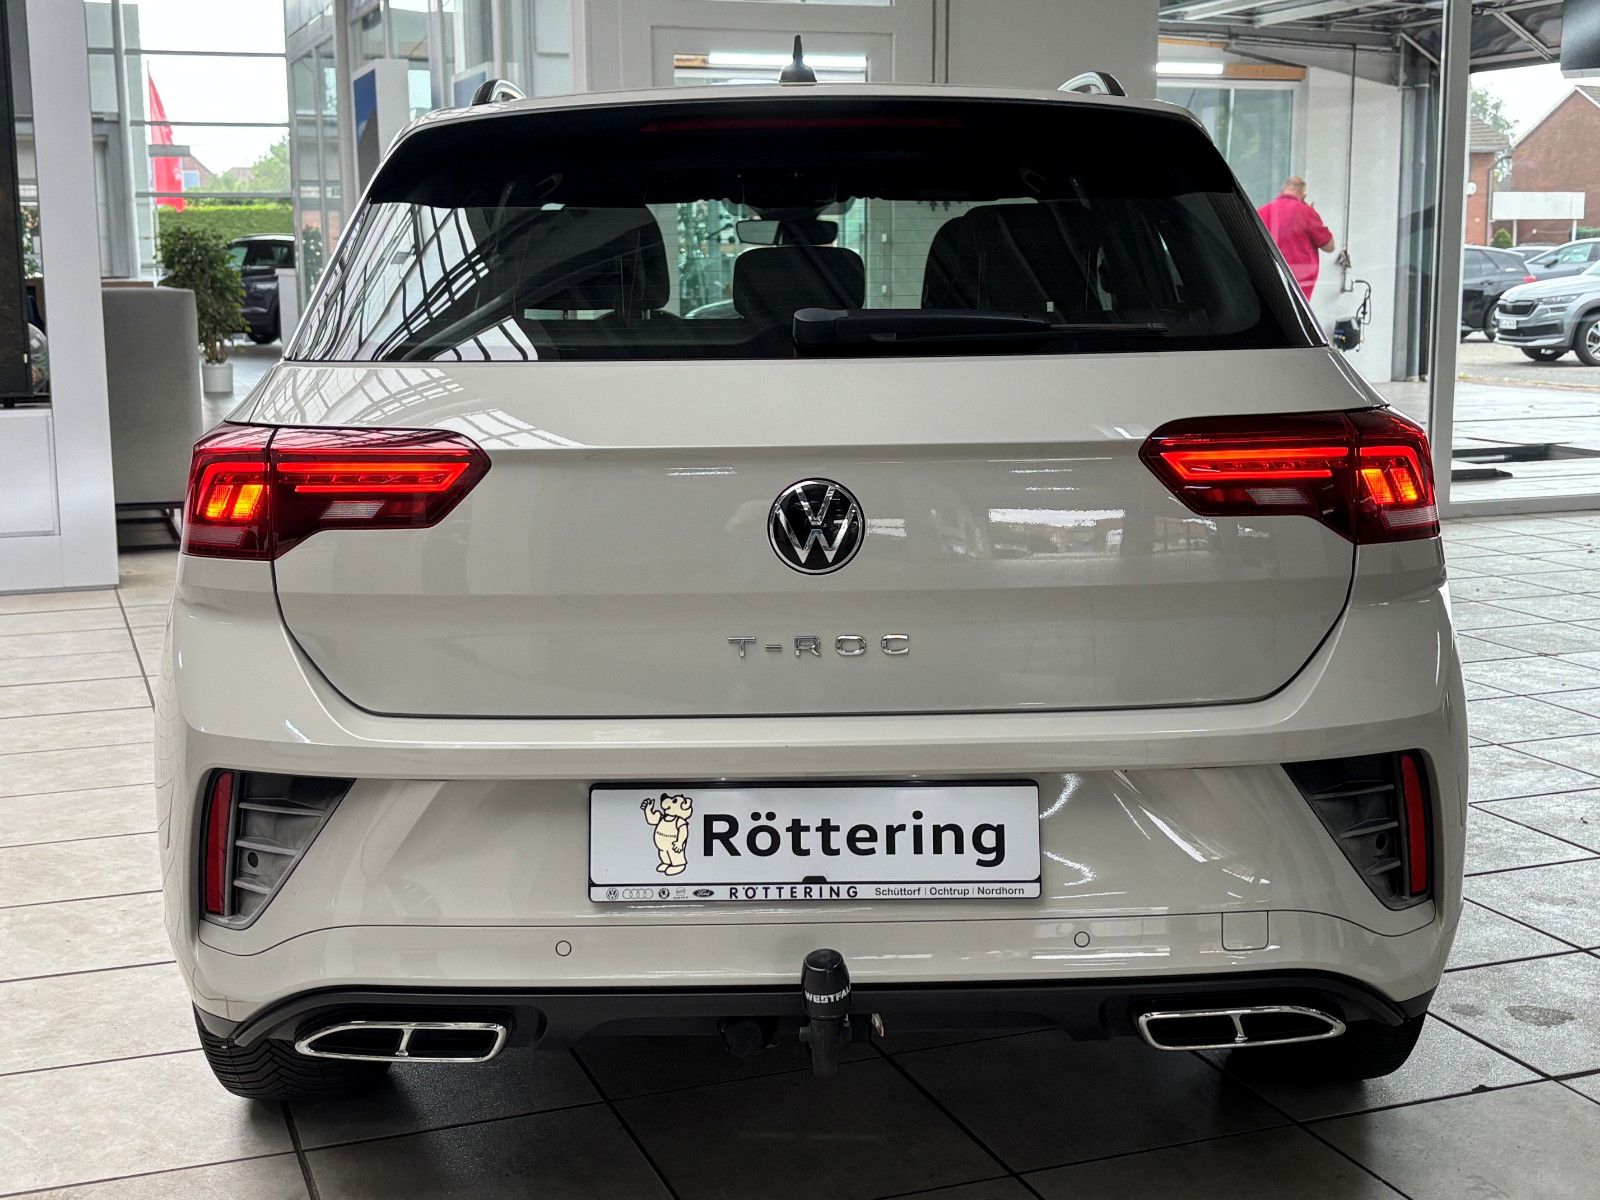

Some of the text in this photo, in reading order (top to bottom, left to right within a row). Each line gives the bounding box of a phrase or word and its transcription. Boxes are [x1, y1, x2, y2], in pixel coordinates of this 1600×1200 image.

[728, 634, 909, 657] T-ROC
[703, 810, 1005, 867] Röttering
[729, 885, 858, 899] RÖTTERING
[875, 886, 1025, 896] Schüttorf Ochtrup Nordhorn
